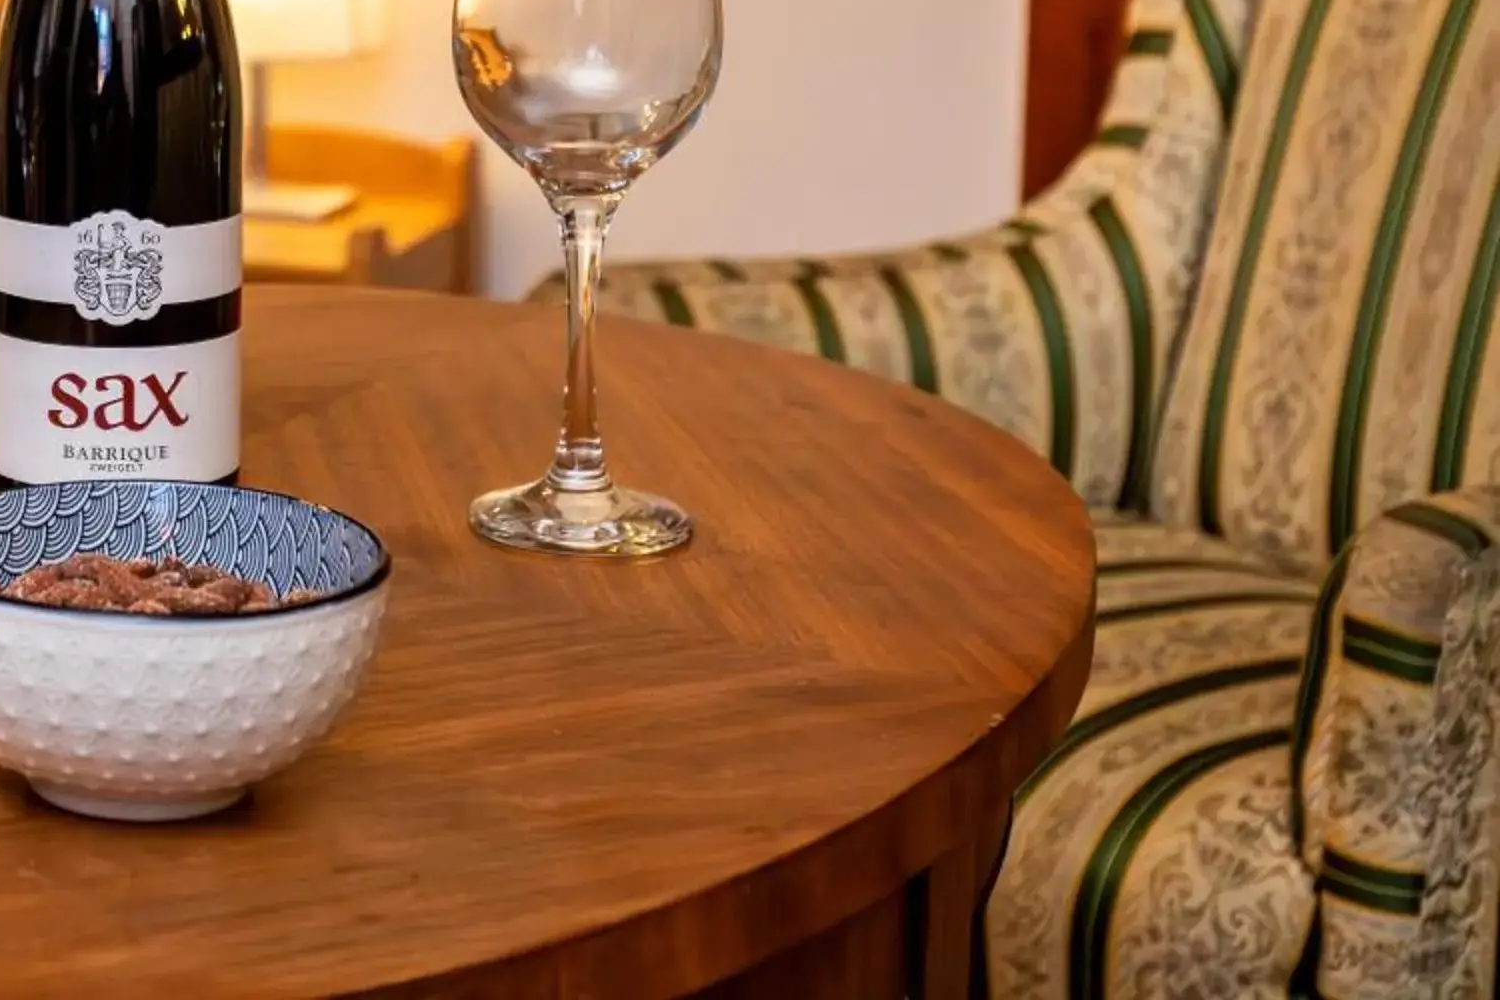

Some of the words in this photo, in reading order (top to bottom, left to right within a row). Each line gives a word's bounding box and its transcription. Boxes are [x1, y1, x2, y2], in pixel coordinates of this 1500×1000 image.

[77, 230, 93, 244] 16
[140, 230, 161, 245] 60
[48, 371, 189, 432] sax
[63, 444, 169, 462] BARRIQUE
[89, 463, 145, 473] ZWEIGELT
